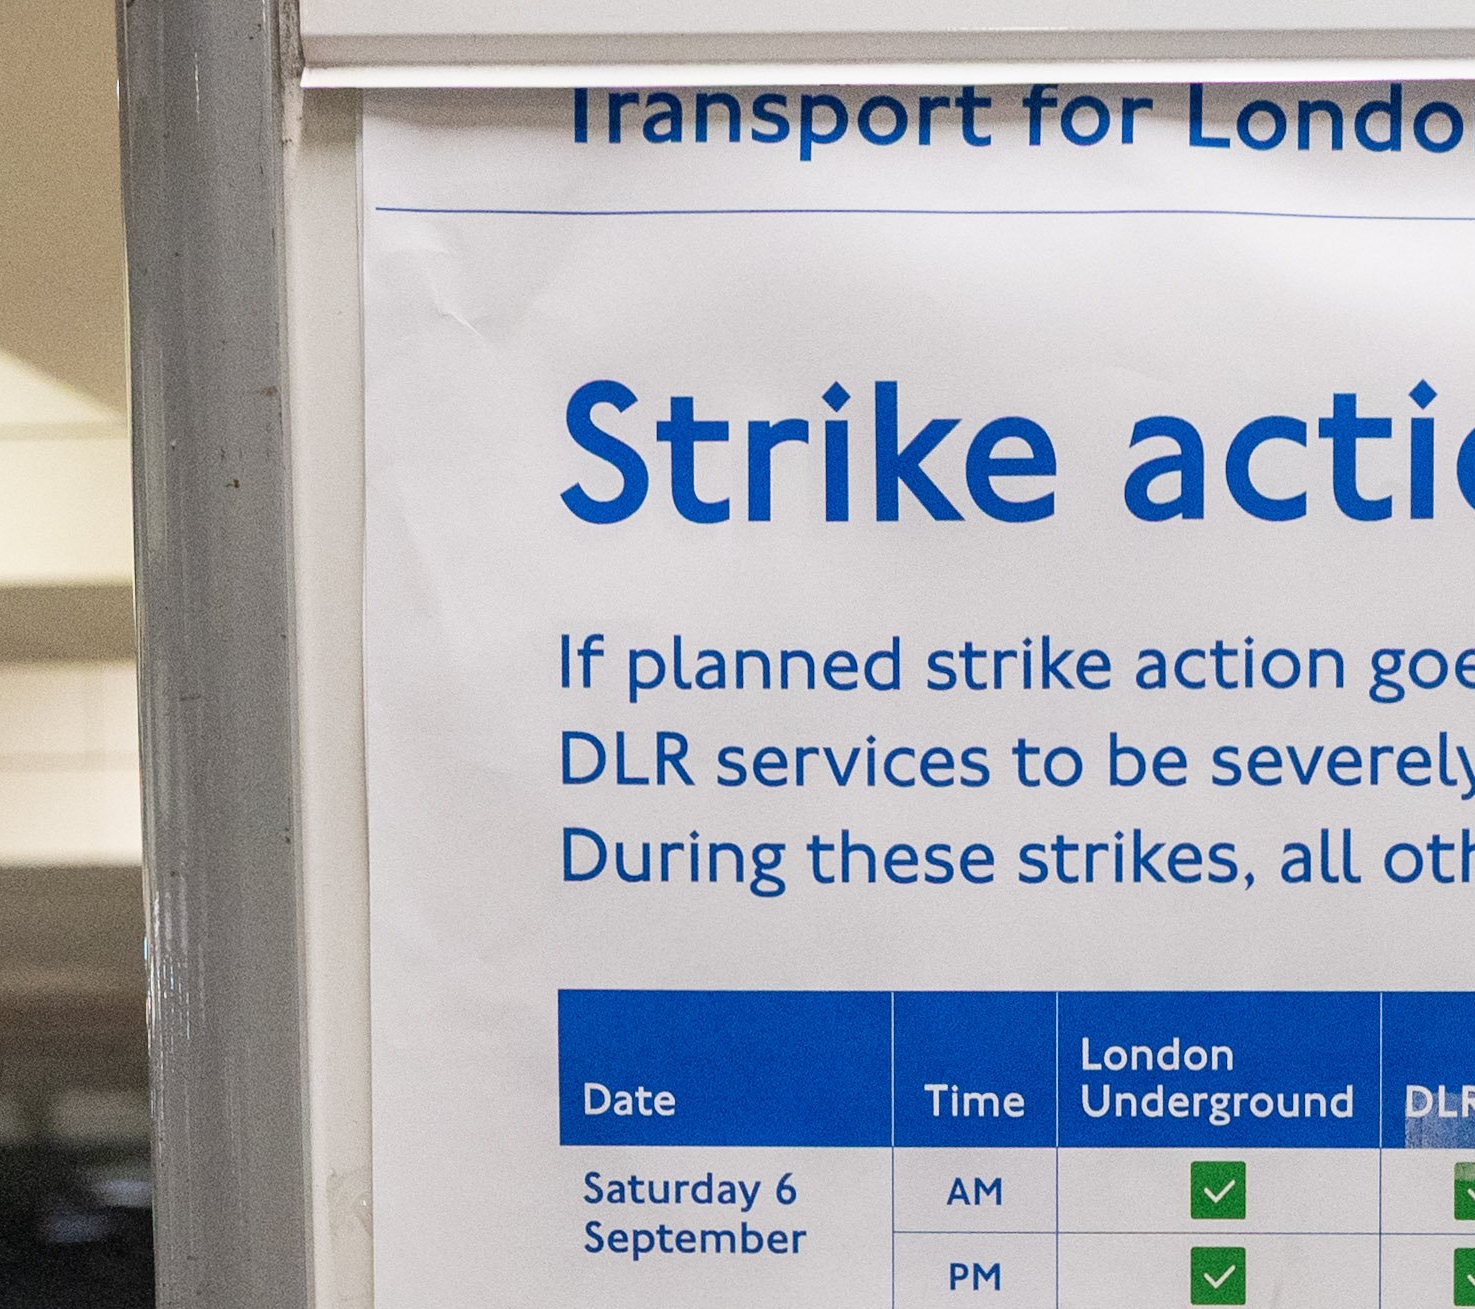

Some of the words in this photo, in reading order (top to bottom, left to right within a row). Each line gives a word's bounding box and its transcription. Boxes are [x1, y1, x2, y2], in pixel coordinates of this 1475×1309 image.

[1025, 85, 1151, 146] for
[561, 380, 1056, 524] Strike
[561, 634, 604, 688] If
[629, 635, 900, 703] planned
[928, 635, 1111, 690] strike
[1136, 637, 1344, 689] action
[562, 731, 693, 785] DLR
[718, 736, 990, 787] services
[1013, 739, 1083, 787] to
[1110, 732, 1187, 786] be
[1083, 1038, 1232, 1070] London
[585, 1083, 675, 1115] Date
[925, 1084, 1024, 1117] Time
[1082, 1085, 1353, 1125] Underground
[585, 1171, 759, 1212] Saturday
[776, 1173, 797, 1204] 6
[949, 1178, 1002, 1205] AM
[585, 1221, 806, 1260] September
[950, 1262, 1001, 1291] PM
